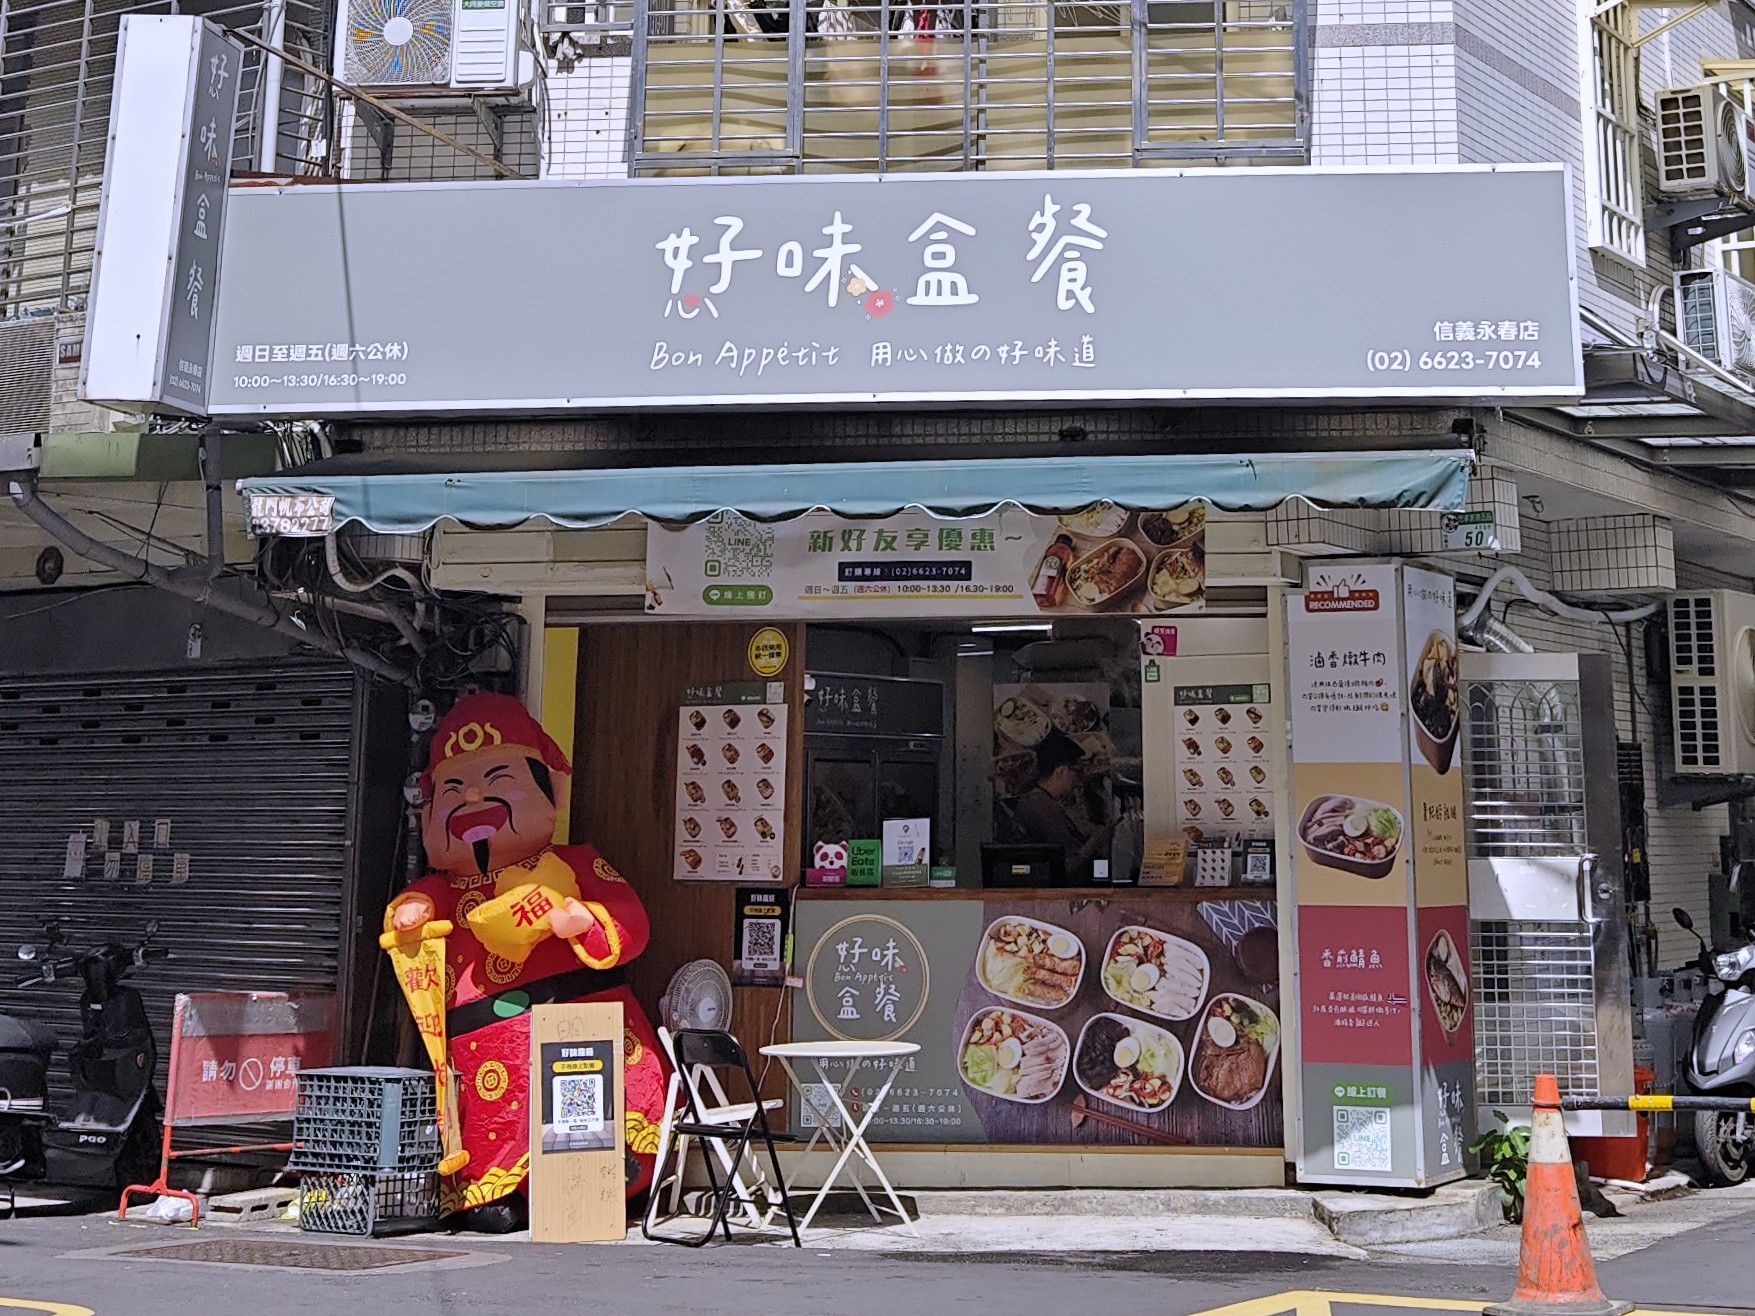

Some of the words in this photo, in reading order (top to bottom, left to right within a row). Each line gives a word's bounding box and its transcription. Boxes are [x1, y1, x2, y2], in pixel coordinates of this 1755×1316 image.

[655, 193, 1108, 318] 好味盒餐
[1434, 320, 1540, 341] 信義永春店
[234, 341, 408, 362] 週日至週五(週六公休)
[650, 342, 702, 370] Bon
[715, 340, 839, 376] Appétit
[870, 334, 1096, 367] 用心做の好味道
[1366, 349, 1411, 371] (02)
[1418, 351, 1541, 370] 6623-7074
[727, 537, 751, 547] LINE
[1465, 531, 1484, 547] 50
[1309, 600, 1375, 610] RECOMMENDED
[1309, 650, 1386, 669] 滷香燉牛肉
[851, 856, 875, 866] Eats
[852, 846, 875, 856] Uber
[510, 885, 554, 927] 福
[835, 937, 904, 973] 好味
[1321, 948, 1383, 969] 香煎鯖魚
[834, 971, 851, 982] Bon
[836, 982, 901, 1022] 盒餐
[202, 1060, 236, 1082] 請勿
[270, 1056, 302, 1078] 停車
